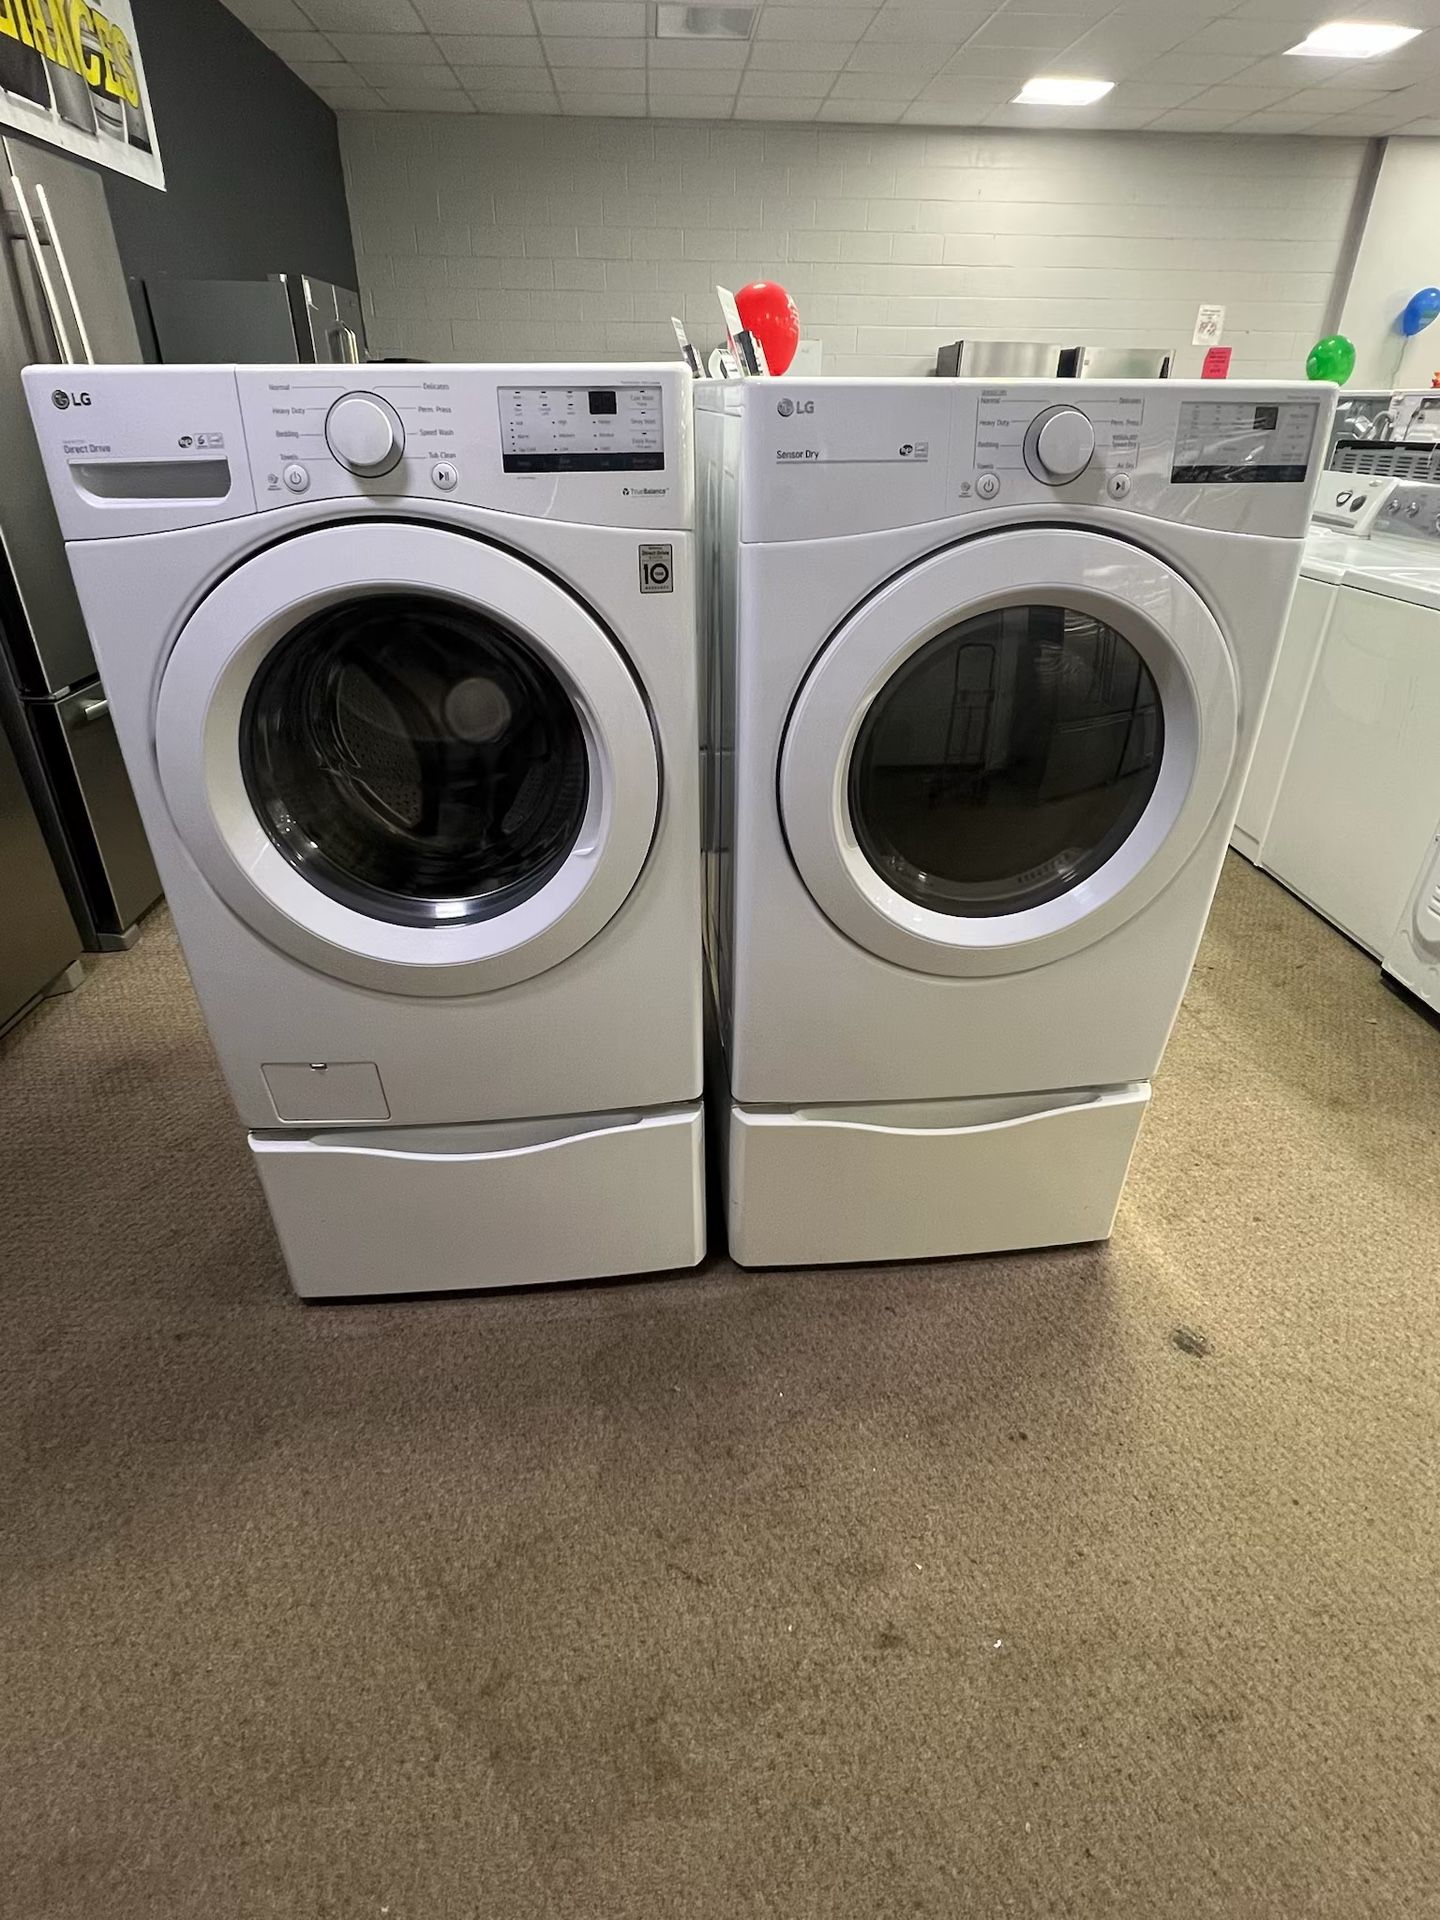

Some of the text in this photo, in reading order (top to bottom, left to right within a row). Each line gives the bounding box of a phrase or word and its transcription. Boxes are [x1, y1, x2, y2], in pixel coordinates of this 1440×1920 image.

[71, 392, 91, 406] LG
[273, 407, 290, 416] Heavy
[796, 401, 814, 414] LG
[276, 430, 298, 439] Bedding
[419, 429, 438, 437] Speed
[64, 444, 111, 454] Direct Drive
[776, 450, 819, 460] Sensor Dry
[643, 563, 669, 584] 10
